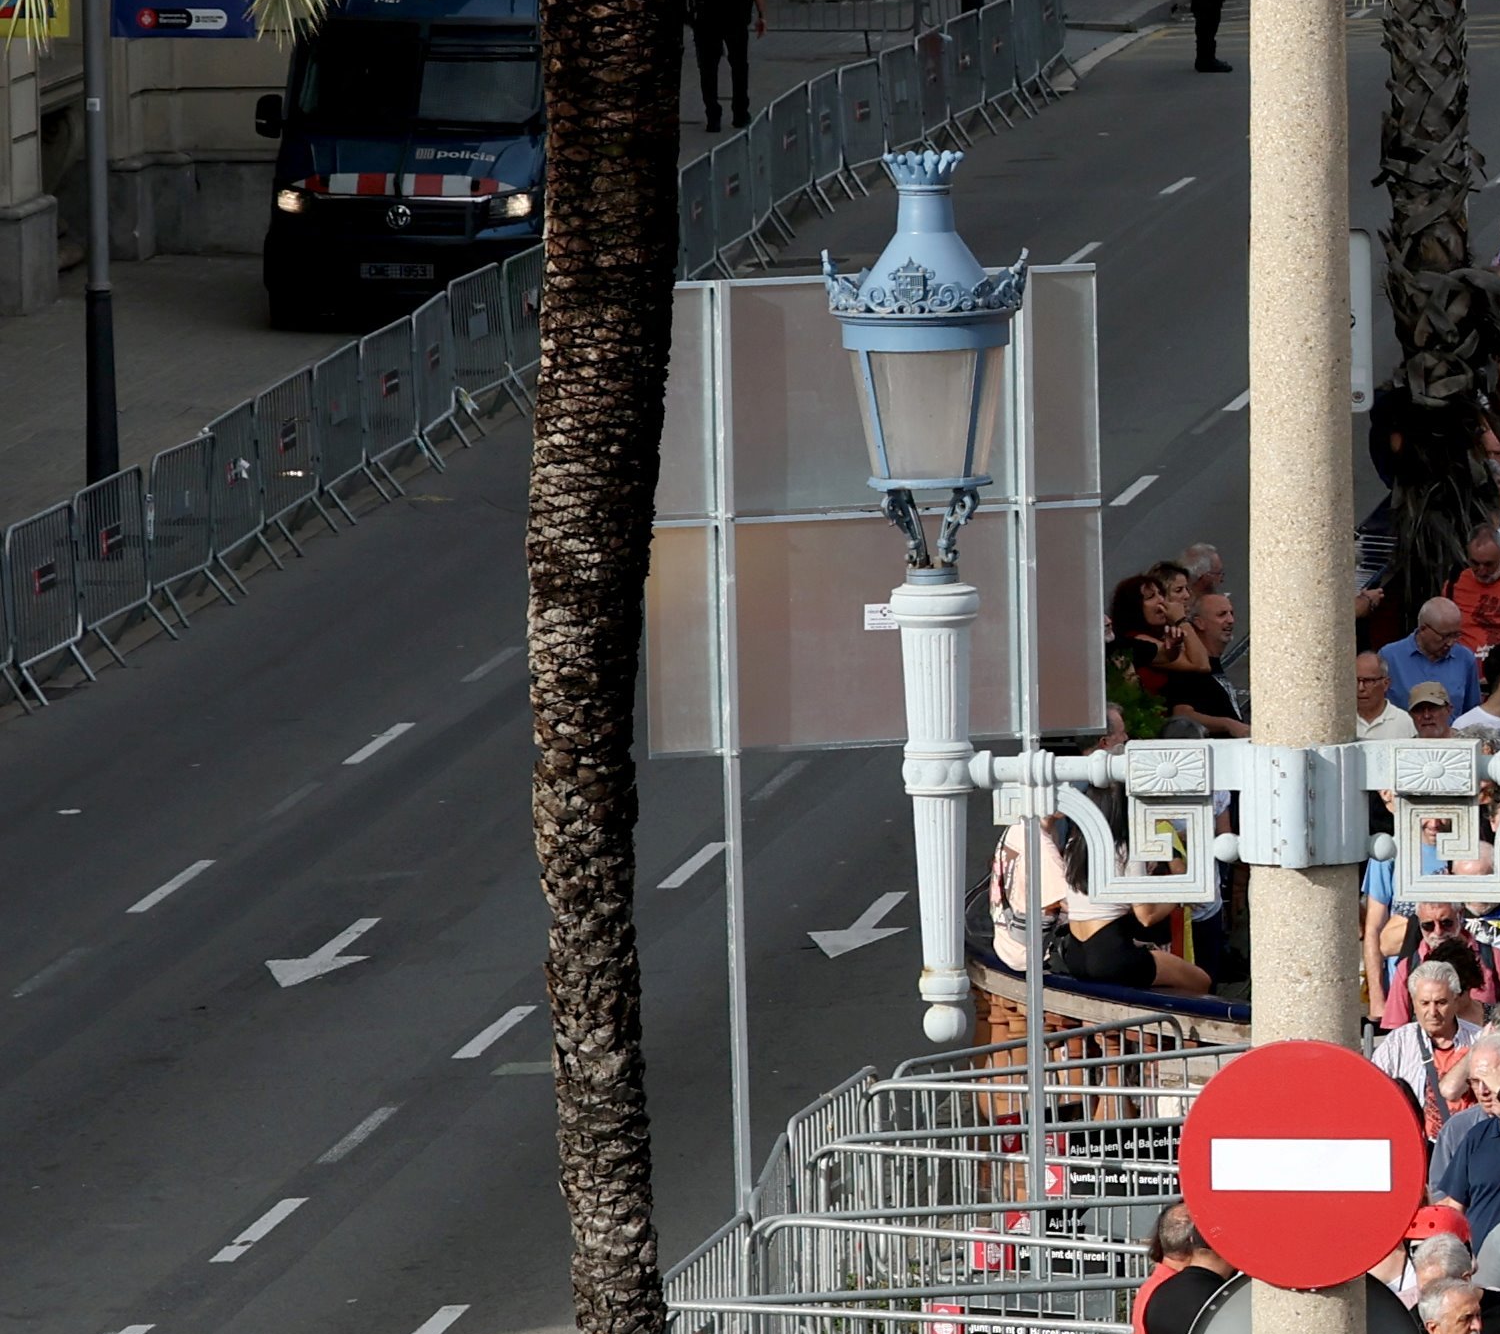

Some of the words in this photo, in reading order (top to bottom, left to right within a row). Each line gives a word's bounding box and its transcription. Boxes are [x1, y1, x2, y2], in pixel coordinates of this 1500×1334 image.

[436, 149, 496, 163] policia
[1139, 1136, 1181, 1149] Bacelna
[1132, 1174, 1178, 1186] arcelna
